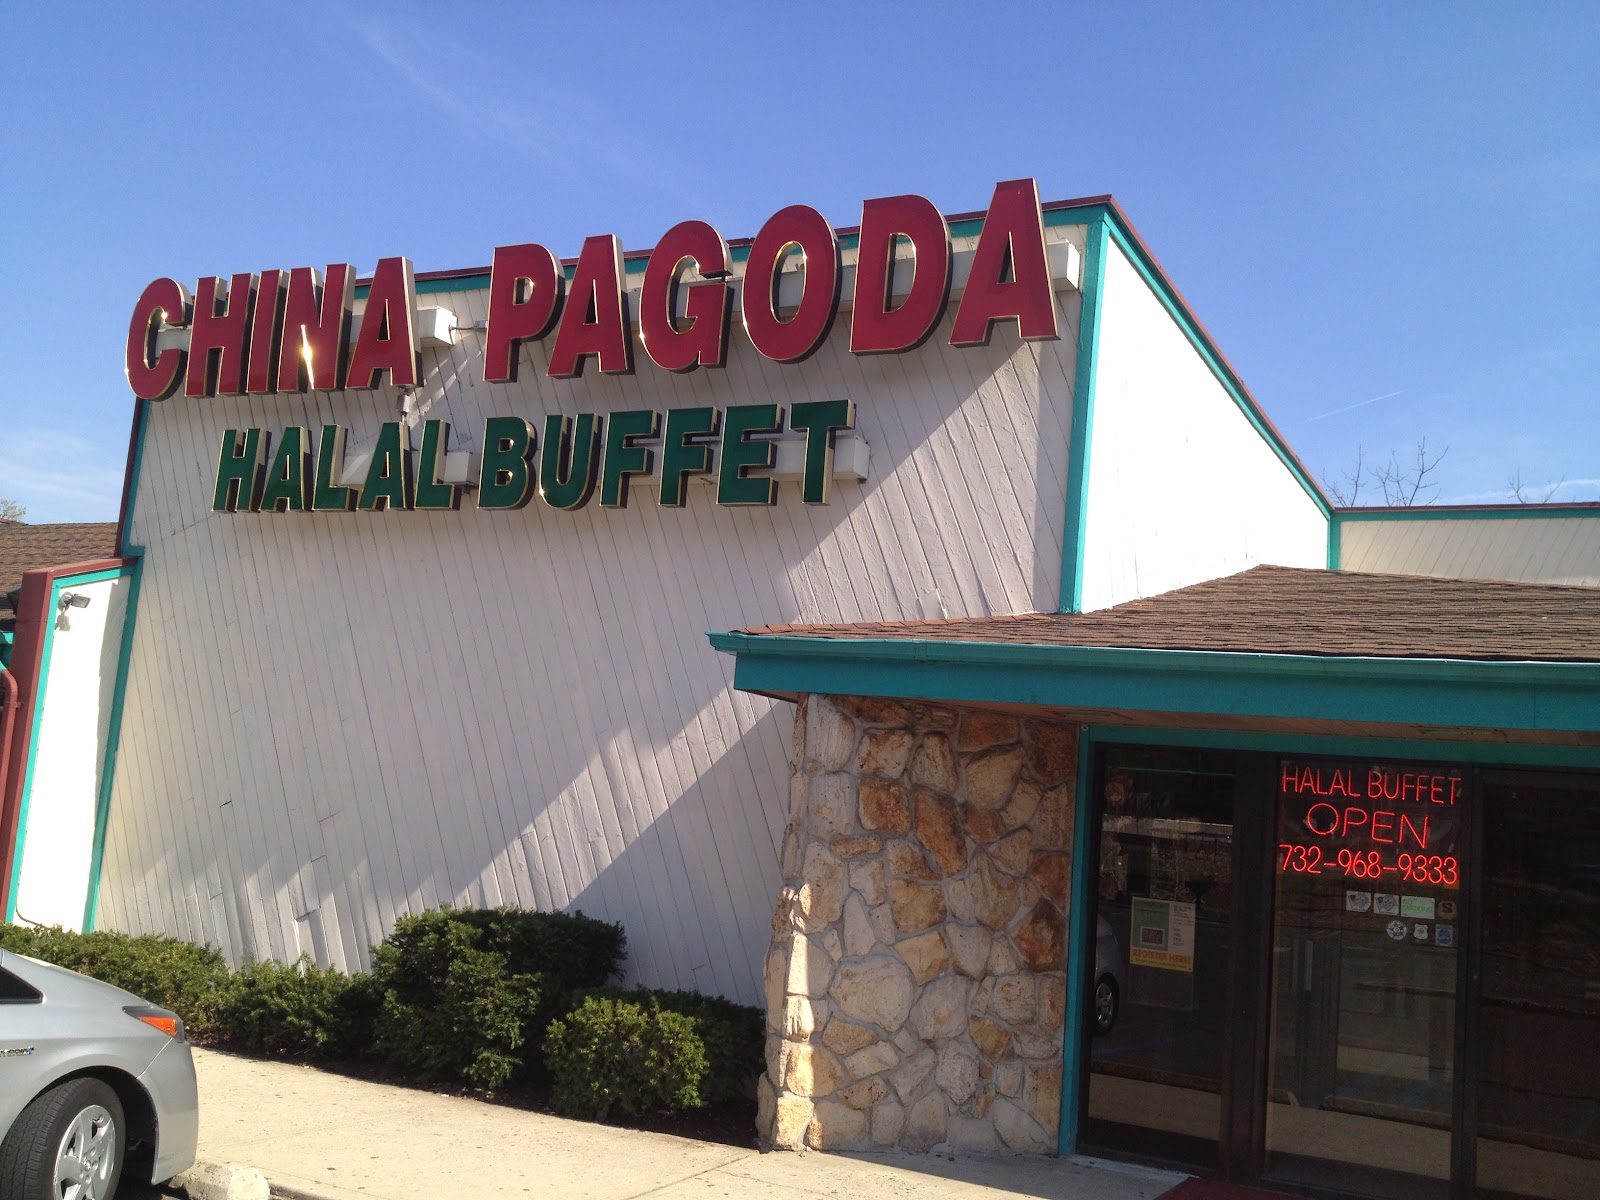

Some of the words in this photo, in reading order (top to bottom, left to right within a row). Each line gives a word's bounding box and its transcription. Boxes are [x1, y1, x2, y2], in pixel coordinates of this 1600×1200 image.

[126, 256, 422, 400] CHINA
[484, 178, 1059, 382] PAGODA
[212, 419, 460, 512] HALAL
[477, 400, 856, 509] BUFFET
[1281, 767, 1361, 798] HALAL
[1367, 770, 1462, 805] BUFFET
[1306, 803, 1430, 849] OPEN
[1279, 844, 1458, 885] 732-968-9333
[1133, 949, 1167, 960] REGISTER
